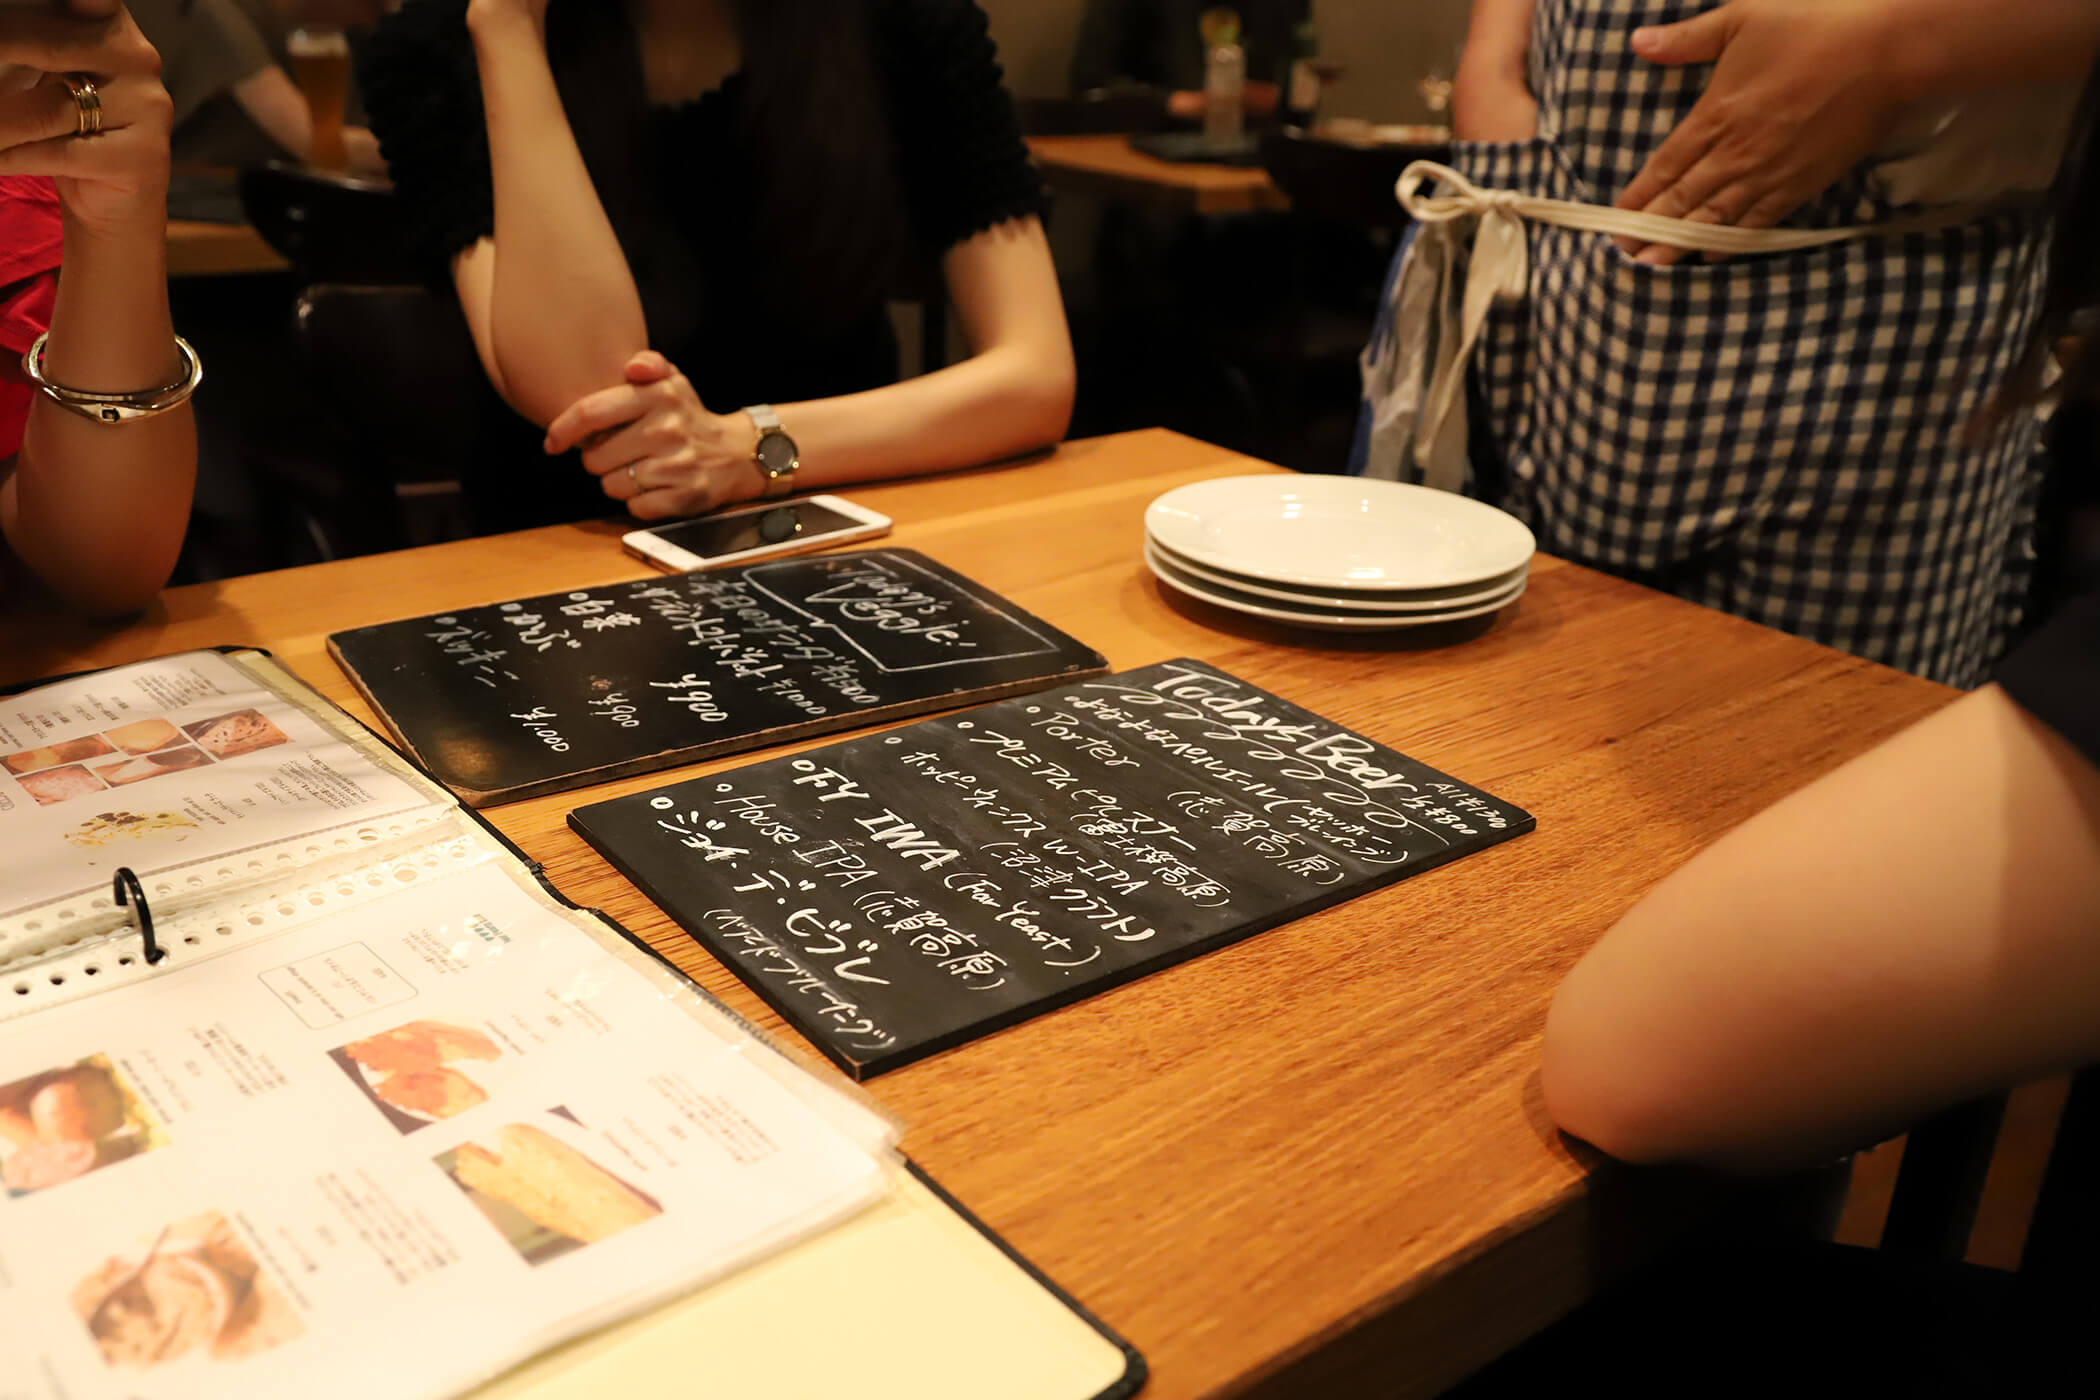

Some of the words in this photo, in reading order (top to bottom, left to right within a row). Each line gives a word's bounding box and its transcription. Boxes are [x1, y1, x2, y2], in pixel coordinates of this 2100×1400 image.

[559, 600, 641, 633] 白菜
[1030, 711, 1141, 768] Porter
[1152, 664, 1317, 743] Today's
[1295, 733, 1418, 793] Beer
[713, 795, 801, 845] House
[791, 839, 879, 888] IPA
